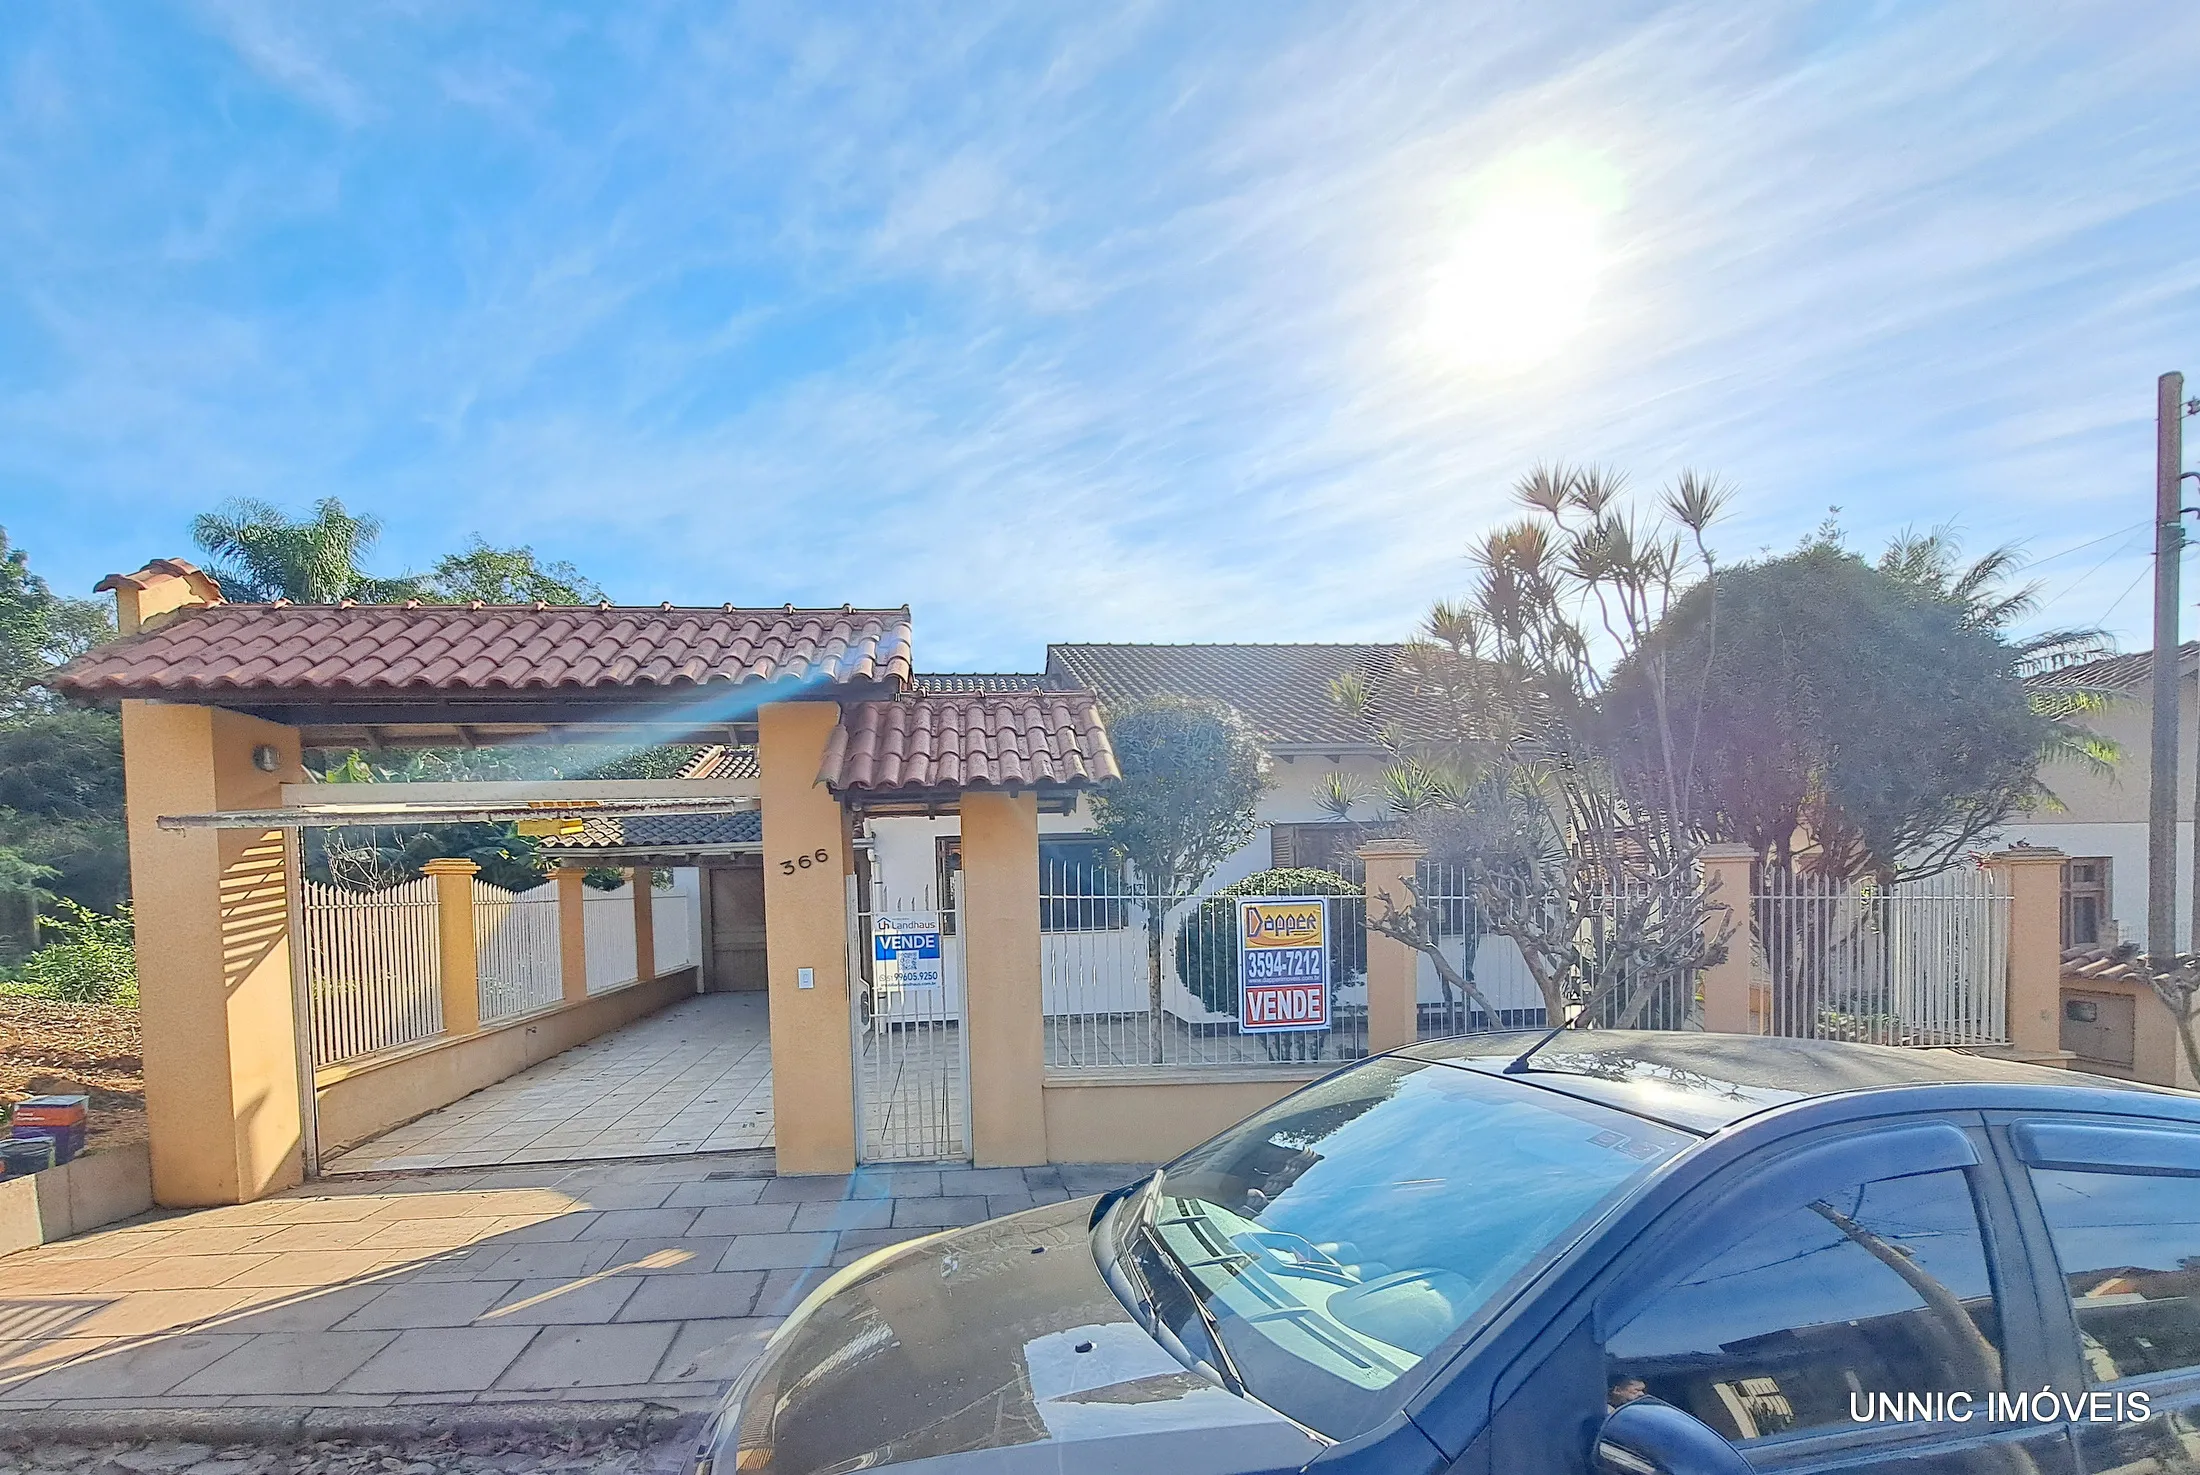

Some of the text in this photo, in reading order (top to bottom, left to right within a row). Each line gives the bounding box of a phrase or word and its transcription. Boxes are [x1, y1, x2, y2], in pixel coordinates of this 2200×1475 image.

[780, 848, 828, 875] 366
[891, 920, 936, 929] Landhaus
[880, 935, 935, 950] VENDE
[1248, 950, 1320, 978] 3594-7212
[1247, 989, 1320, 1021] VENDE
